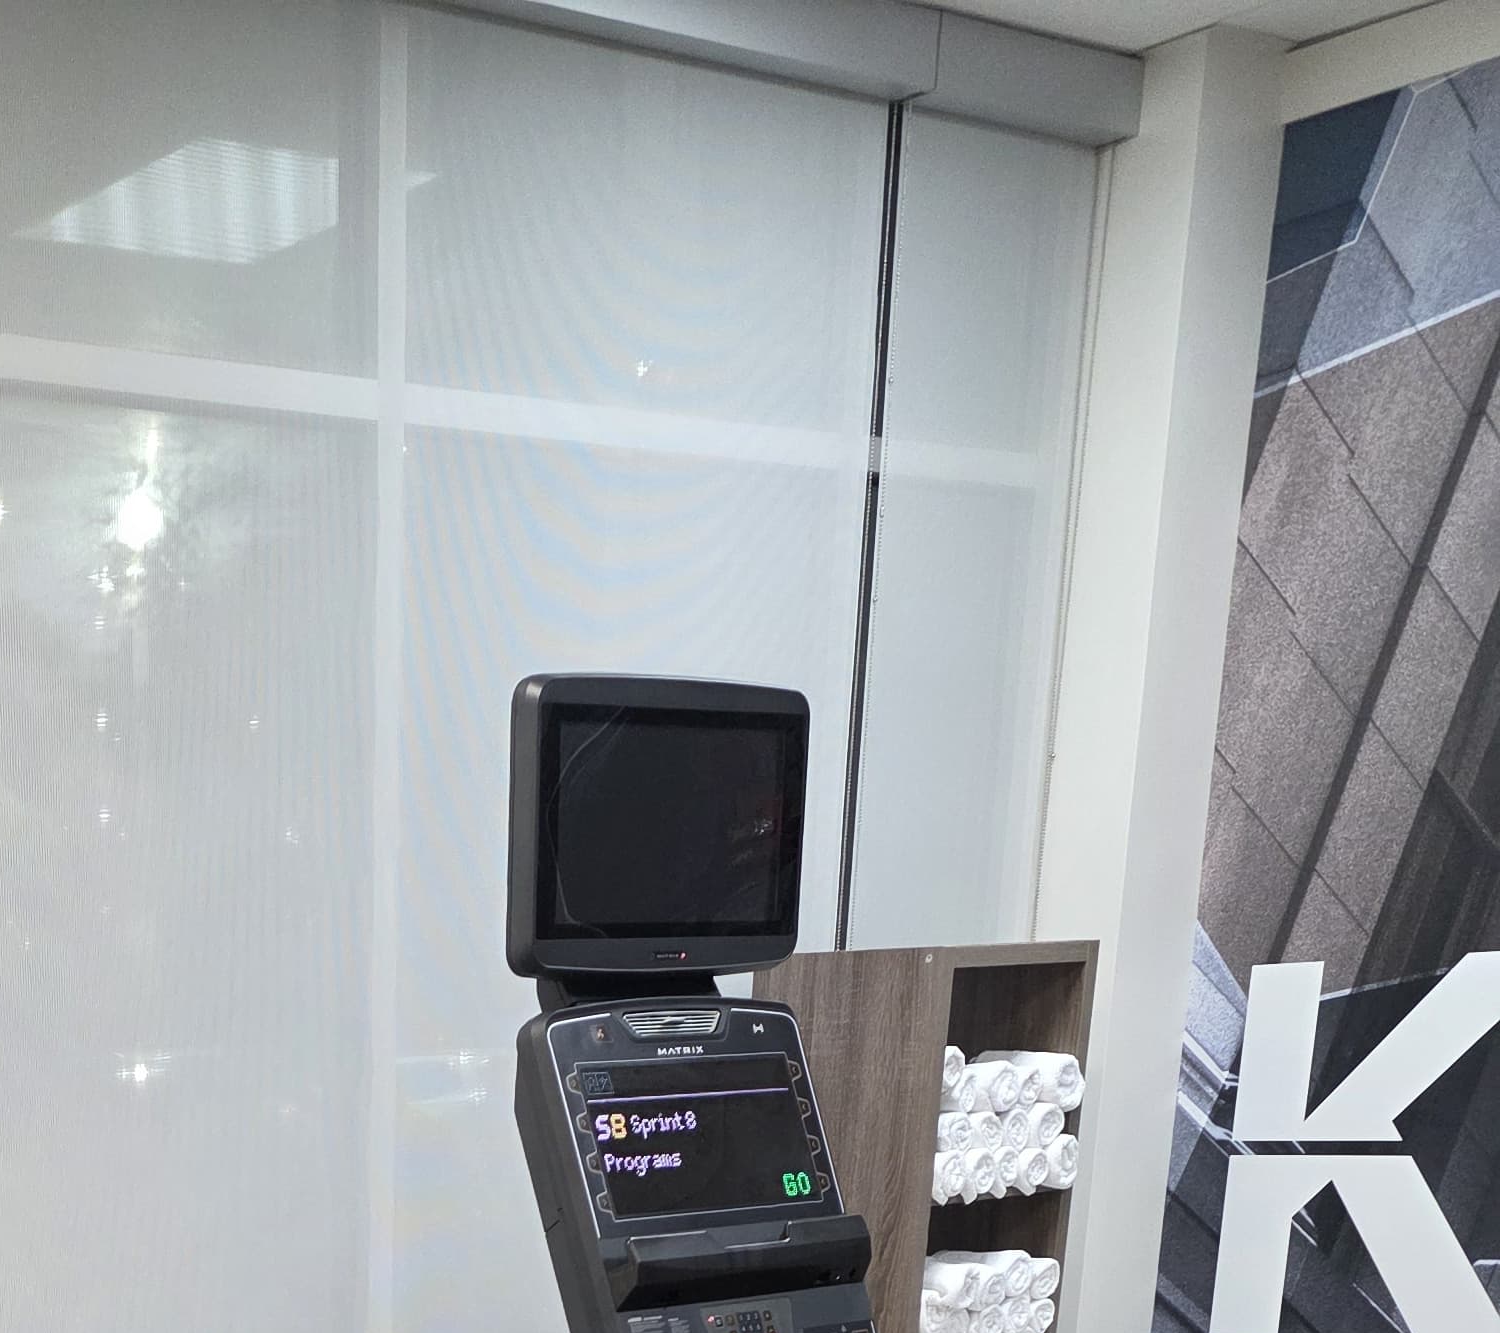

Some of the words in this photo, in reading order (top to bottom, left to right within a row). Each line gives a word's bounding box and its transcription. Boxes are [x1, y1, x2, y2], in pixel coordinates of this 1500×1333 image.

[657, 1045, 704, 1056] MATRIX
[630, 1111, 684, 1139] Sprint
[603, 1152, 683, 1177] Programs
